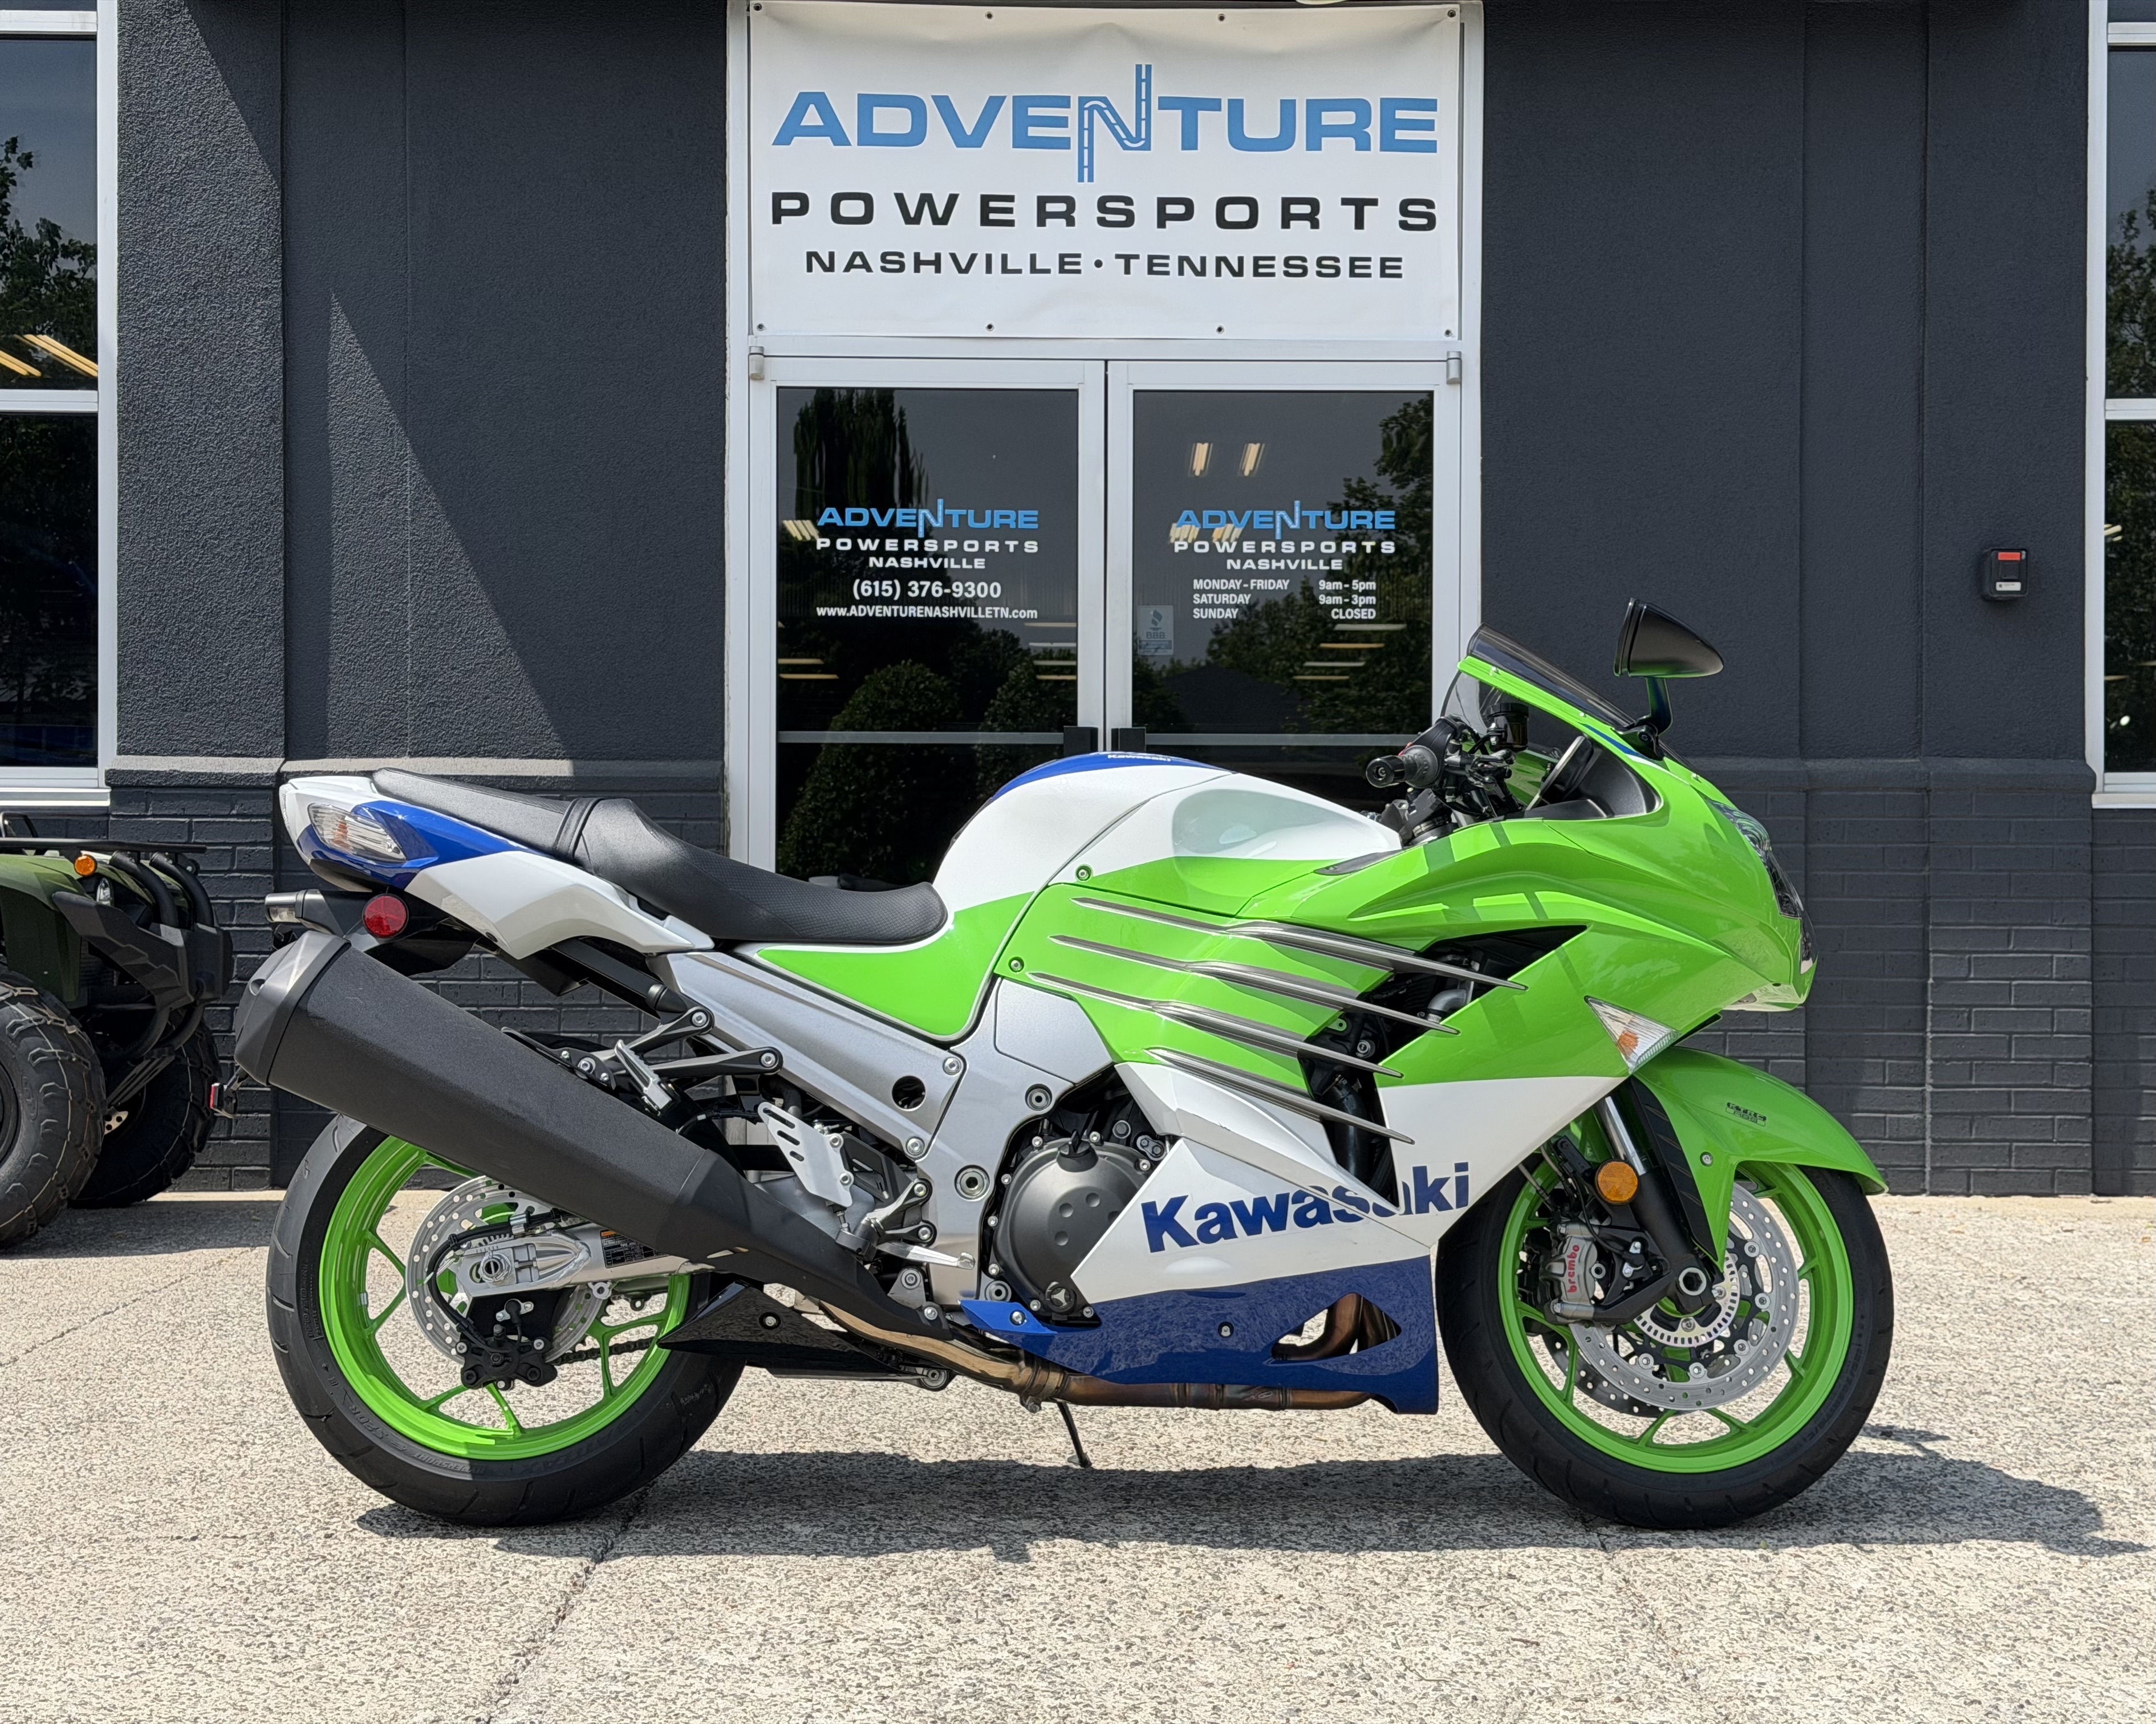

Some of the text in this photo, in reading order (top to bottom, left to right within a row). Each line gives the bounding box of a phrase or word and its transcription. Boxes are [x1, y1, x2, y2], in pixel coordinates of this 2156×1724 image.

[772, 64, 1438, 182] ADVENTURE
[772, 192, 1437, 231] POWERSPORTS
[806, 250, 1403, 279] NASHVILLE TENNESSEE
[817, 499, 1039, 538] ADVENTURE
[1176, 501, 1396, 540] ADVENTURE
[816, 538, 1038, 553] POWERSPORTS
[1174, 540, 1396, 554] POWERSPORTS
[869, 556, 986, 569] NASHVILLE
[1227, 559, 1343, 570] NASHVILLE
[853, 579, 1001, 600] (615) 376-9300
[1192, 593, 1252, 604] SATURDAY
[816, 605, 1038, 619] www.ADVENTURENASHVILLETN.com
[1192, 608, 1377, 619] SUNDAY CLOSED
[1566, 1245, 1580, 1293] brembo
